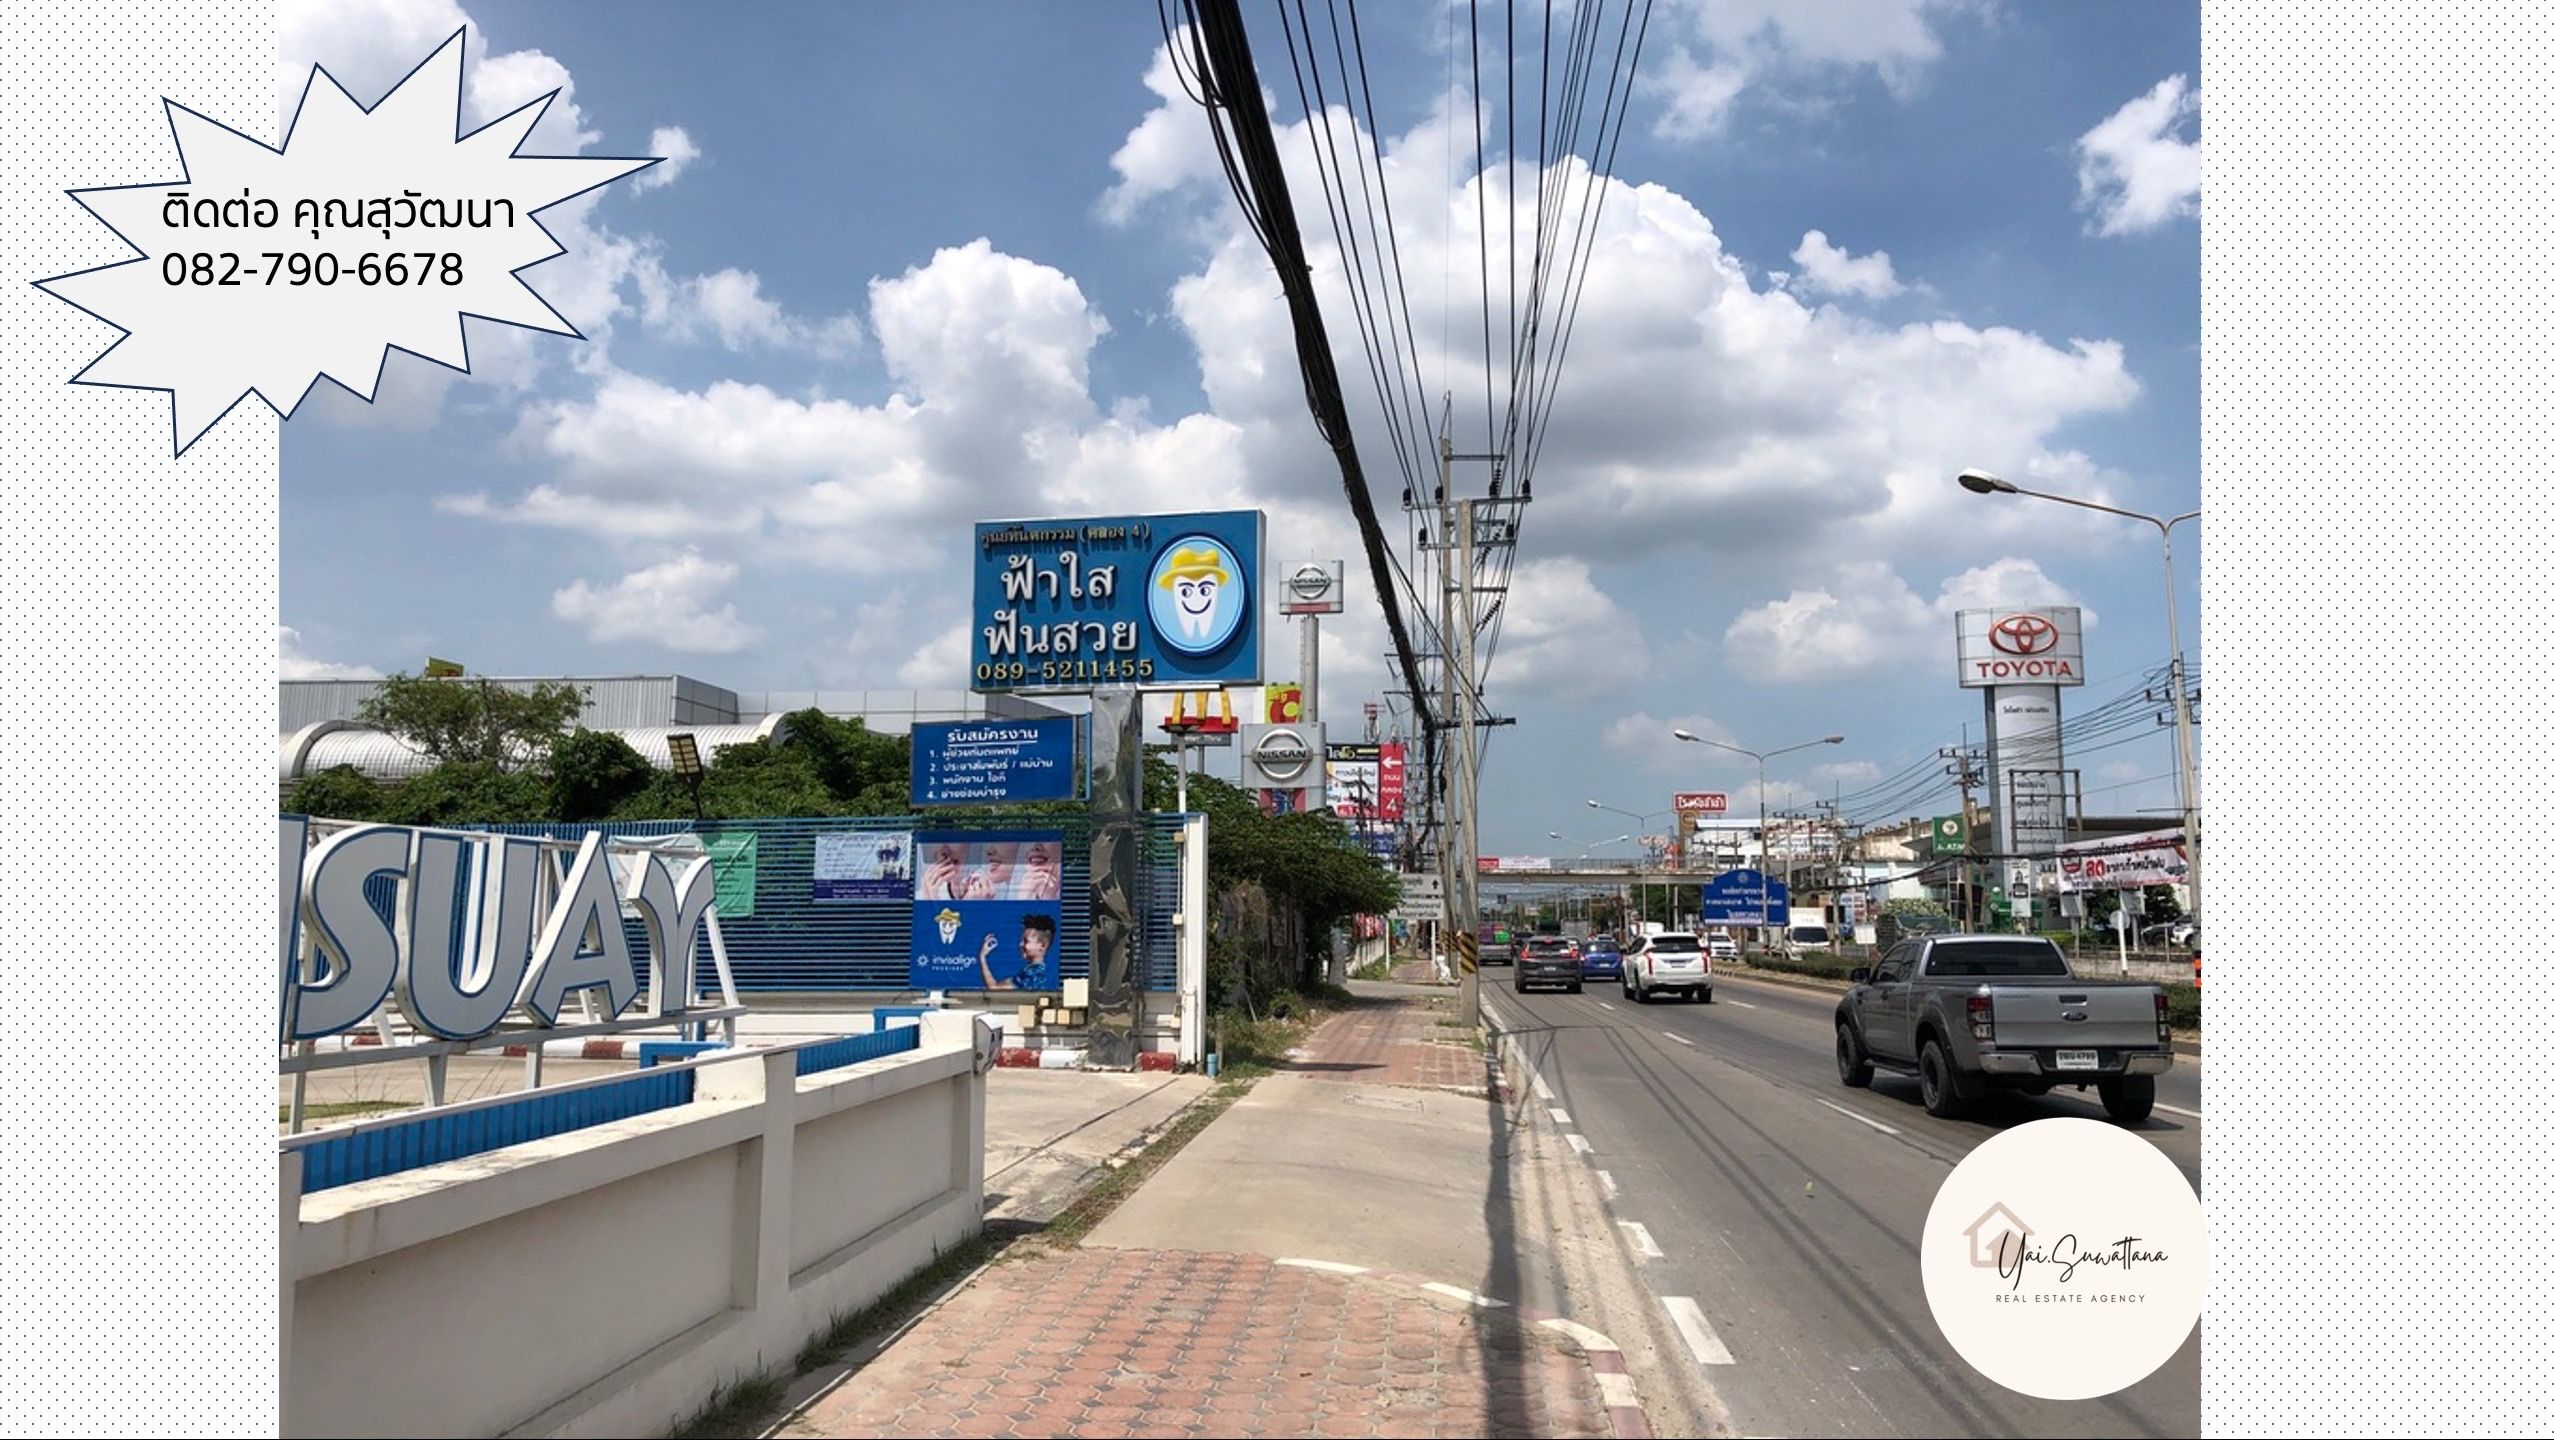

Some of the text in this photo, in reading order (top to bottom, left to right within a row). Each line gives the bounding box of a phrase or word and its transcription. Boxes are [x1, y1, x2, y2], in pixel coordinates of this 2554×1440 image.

[1001, 550, 1116, 601] ฟ้าใส
[1293, 576, 1328, 585] NISSAN
[984, 608, 1138, 656] ฟันสวย
[976, 659, 1154, 681] 089-5211455
[1976, 660, 2073, 679] TOYOTA
[947, 727, 1039, 743] รับสมัครงาน
[1257, 750, 1307, 759] NISSAN
[927, 790, 938, 799] 4.
[1386, 798, 1397, 812] 4
[280, 814, 716, 1056] SUAY
[932, 954, 977, 968] invisalign
